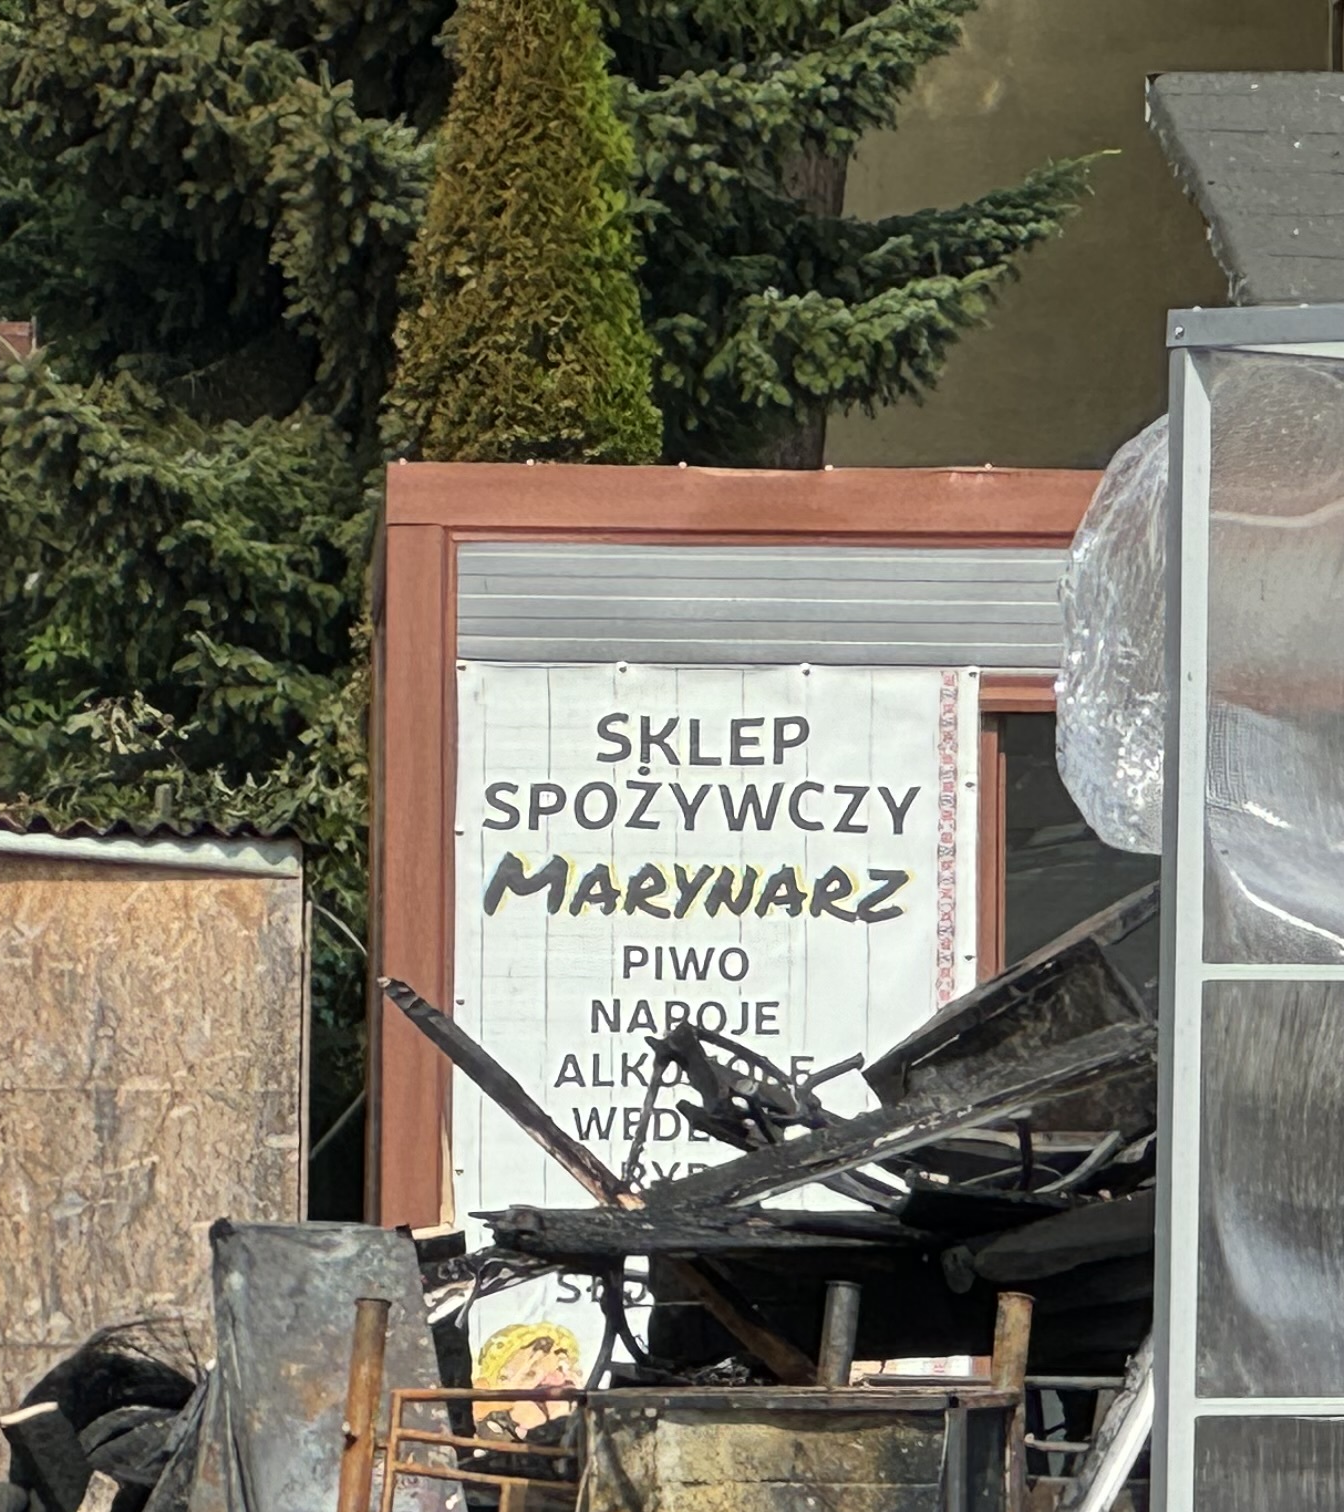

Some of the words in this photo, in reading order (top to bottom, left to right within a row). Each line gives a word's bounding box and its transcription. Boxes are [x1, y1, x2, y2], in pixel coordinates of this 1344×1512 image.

[596, 712, 811, 766] SKLEP
[481, 766, 922, 836] SPOŻYWCZY
[483, 851, 911, 924] MARYNARZ
[622, 945, 750, 981] PIWO
[590, 999, 781, 1036] NAPOJE
